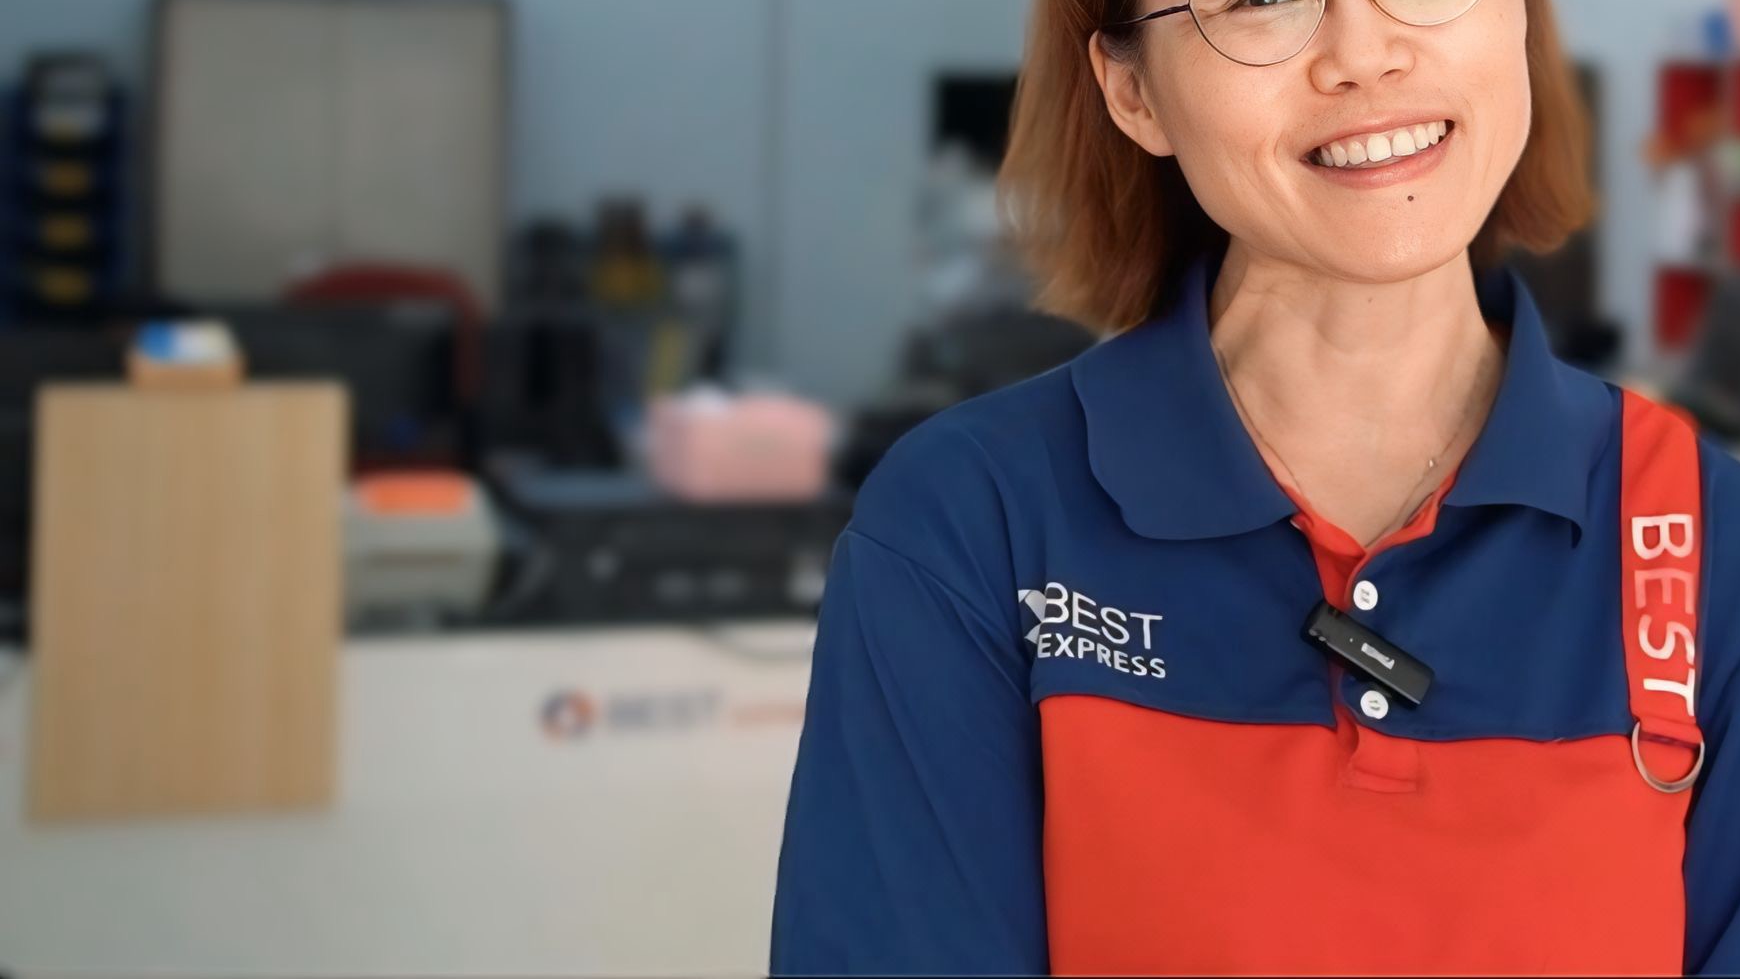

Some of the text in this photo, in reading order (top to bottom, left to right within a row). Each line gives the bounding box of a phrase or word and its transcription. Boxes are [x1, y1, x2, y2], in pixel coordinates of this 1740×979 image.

[1043, 581, 1163, 650] BEST
[1631, 514, 1696, 717] BEST
[1037, 633, 1166, 679] EXPRESS
